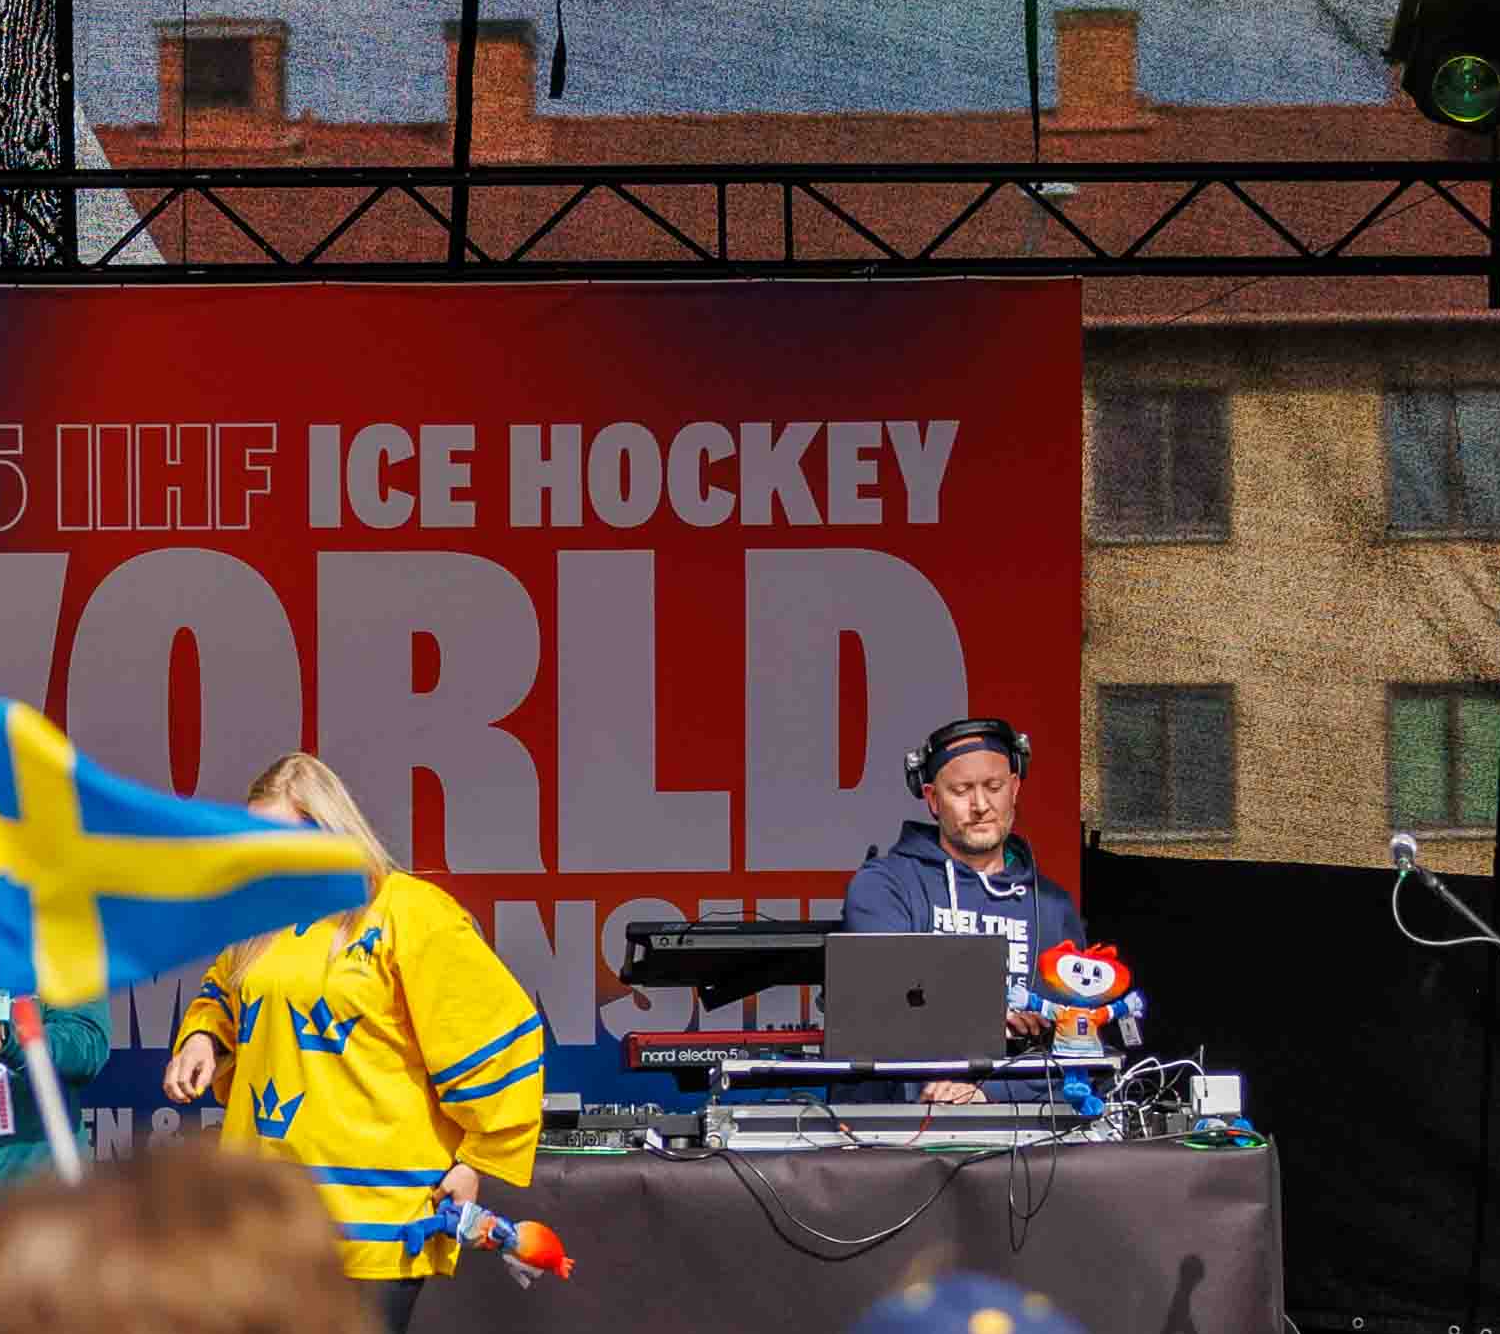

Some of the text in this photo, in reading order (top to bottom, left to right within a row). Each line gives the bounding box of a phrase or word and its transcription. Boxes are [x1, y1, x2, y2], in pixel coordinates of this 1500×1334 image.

[57, 423, 277, 531] IIHF
[308, 423, 476, 530] ICE
[509, 419, 961, 528] HOCKEY
[981, 914, 1029, 941] THE
[641, 1049, 676, 1062] nord
[678, 1048, 728, 1062] electro
